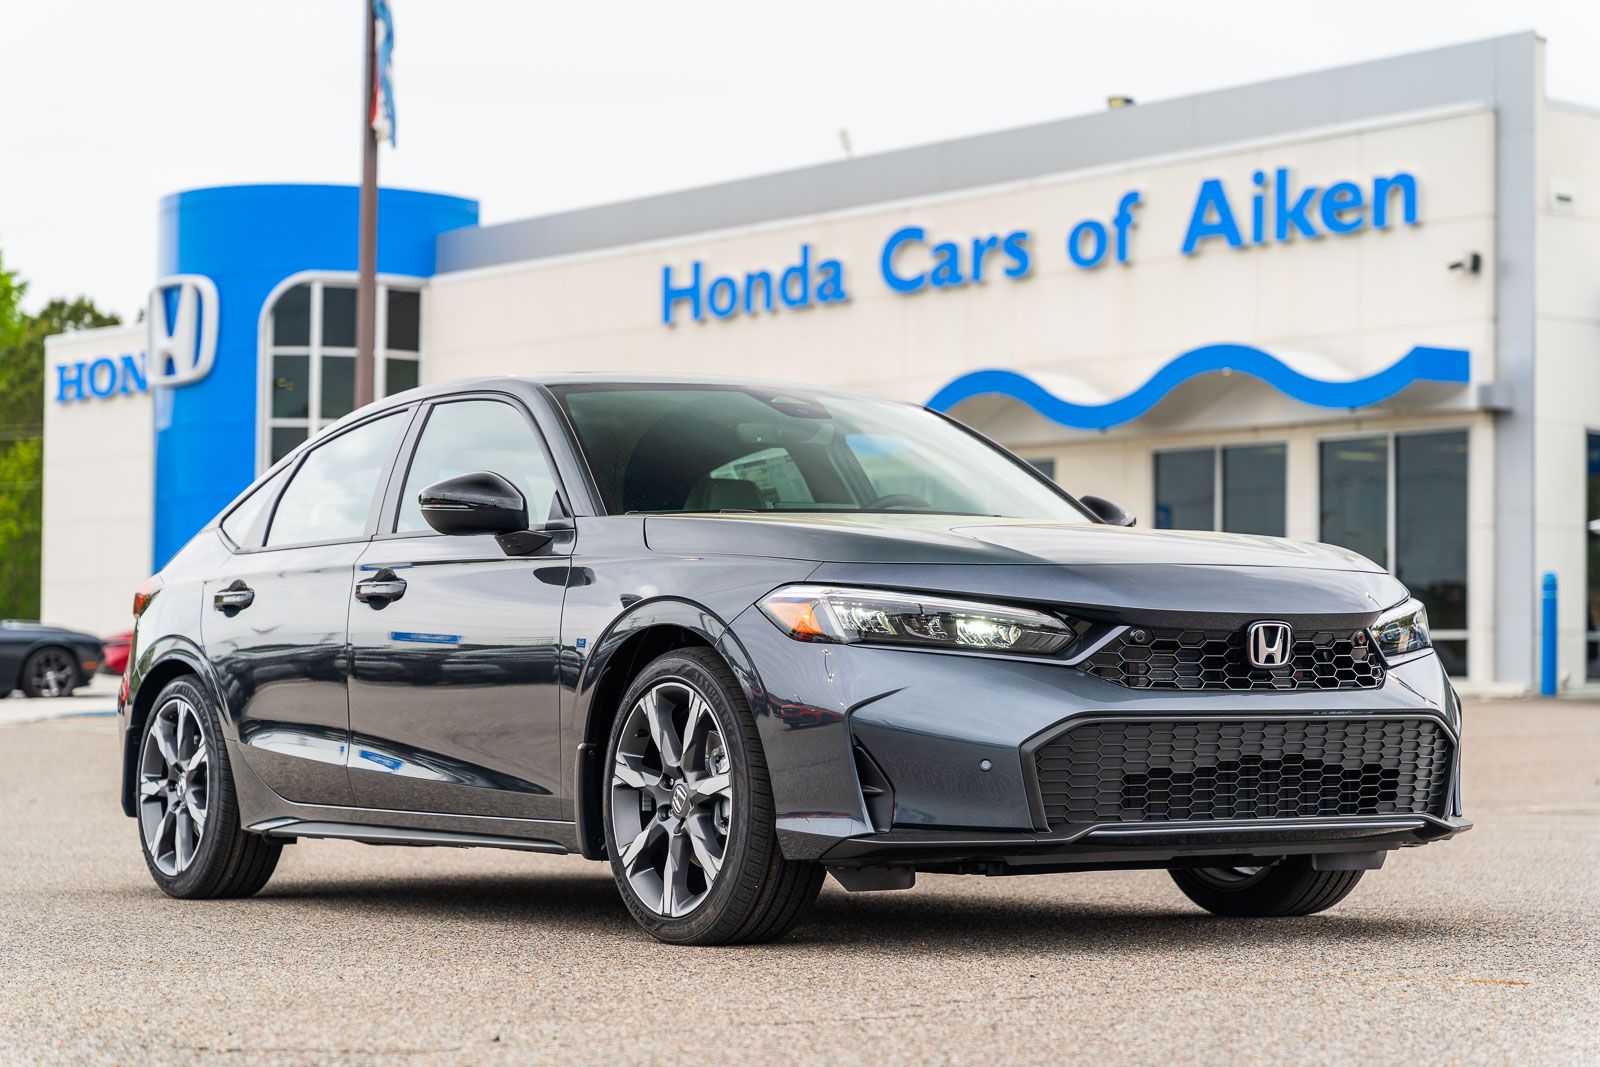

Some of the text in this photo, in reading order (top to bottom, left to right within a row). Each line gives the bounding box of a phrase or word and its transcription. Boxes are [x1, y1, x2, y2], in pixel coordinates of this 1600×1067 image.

[662, 167, 1419, 325] Honda Cars of Aiken
